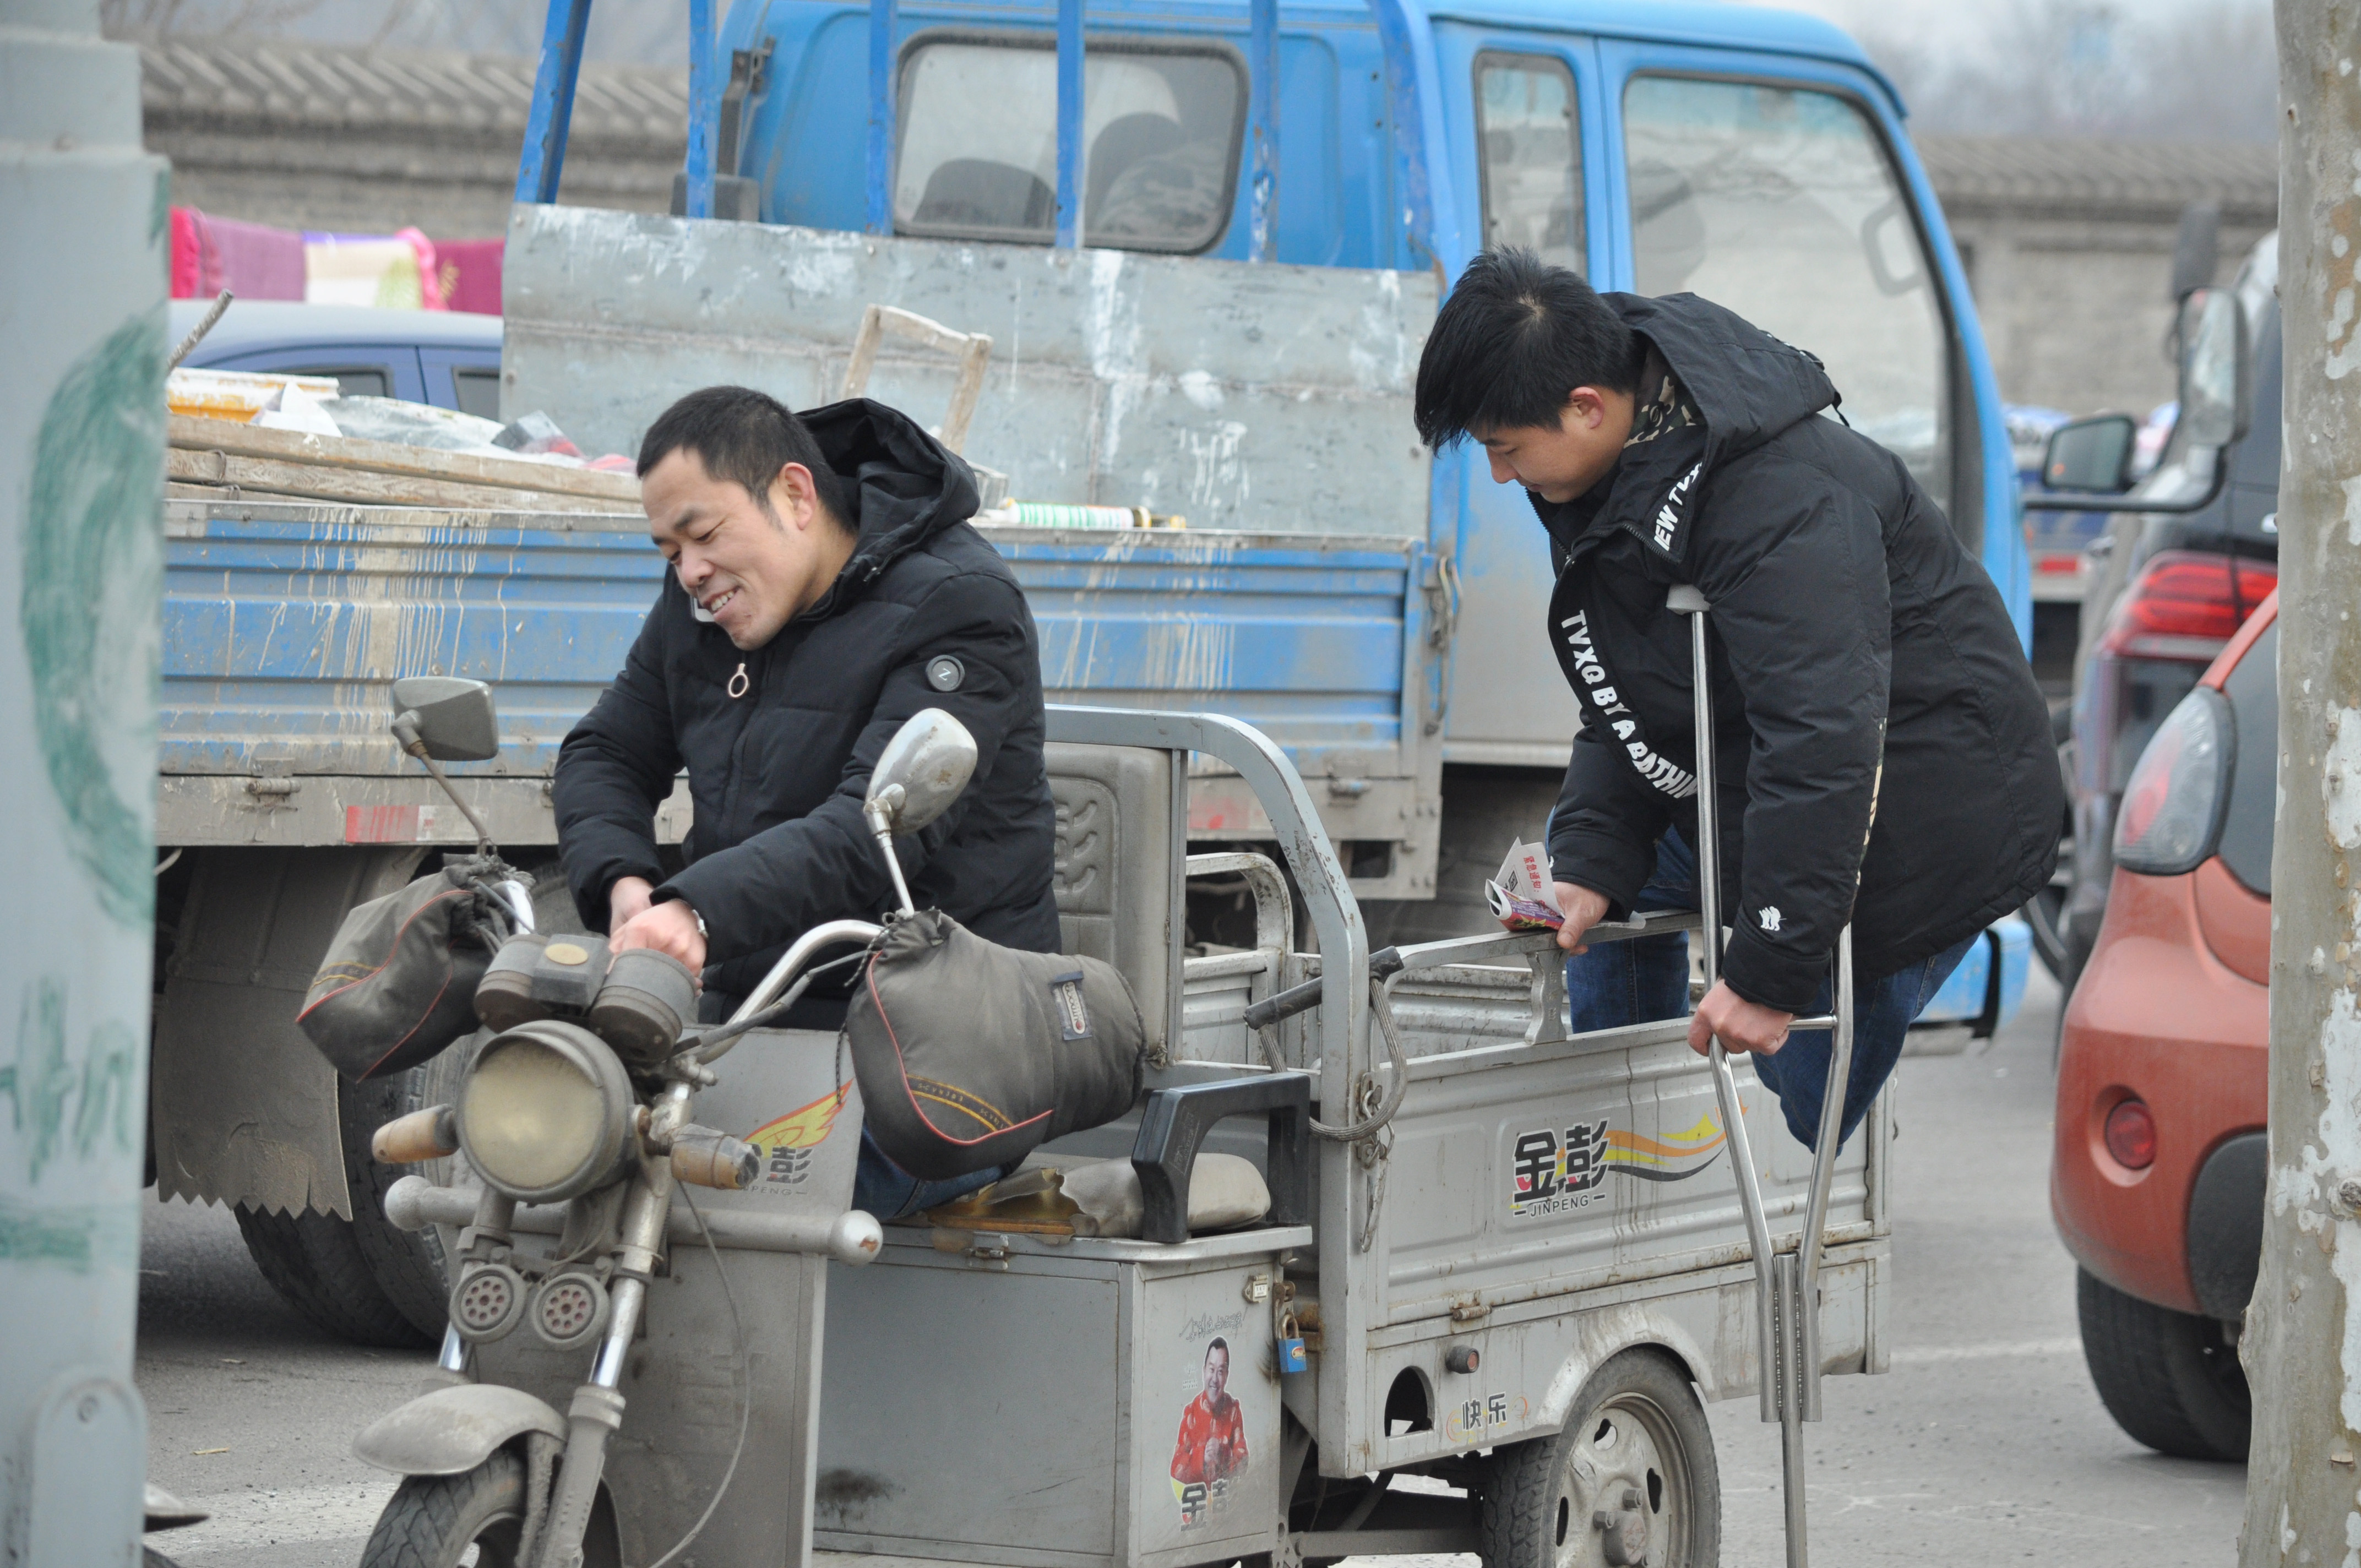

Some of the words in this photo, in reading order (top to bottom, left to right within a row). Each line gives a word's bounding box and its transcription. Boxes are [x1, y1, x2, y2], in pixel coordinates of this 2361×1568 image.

[1561, 609, 1606, 685] TVXQ
[1591, 686, 1632, 715] BY
[1612, 720, 1636, 741] A
[1513, 1119, 1609, 1204] 金彭
[1530, 1195, 1589, 1217] JINPENG
[1462, 1392, 1506, 1431] 快乐
